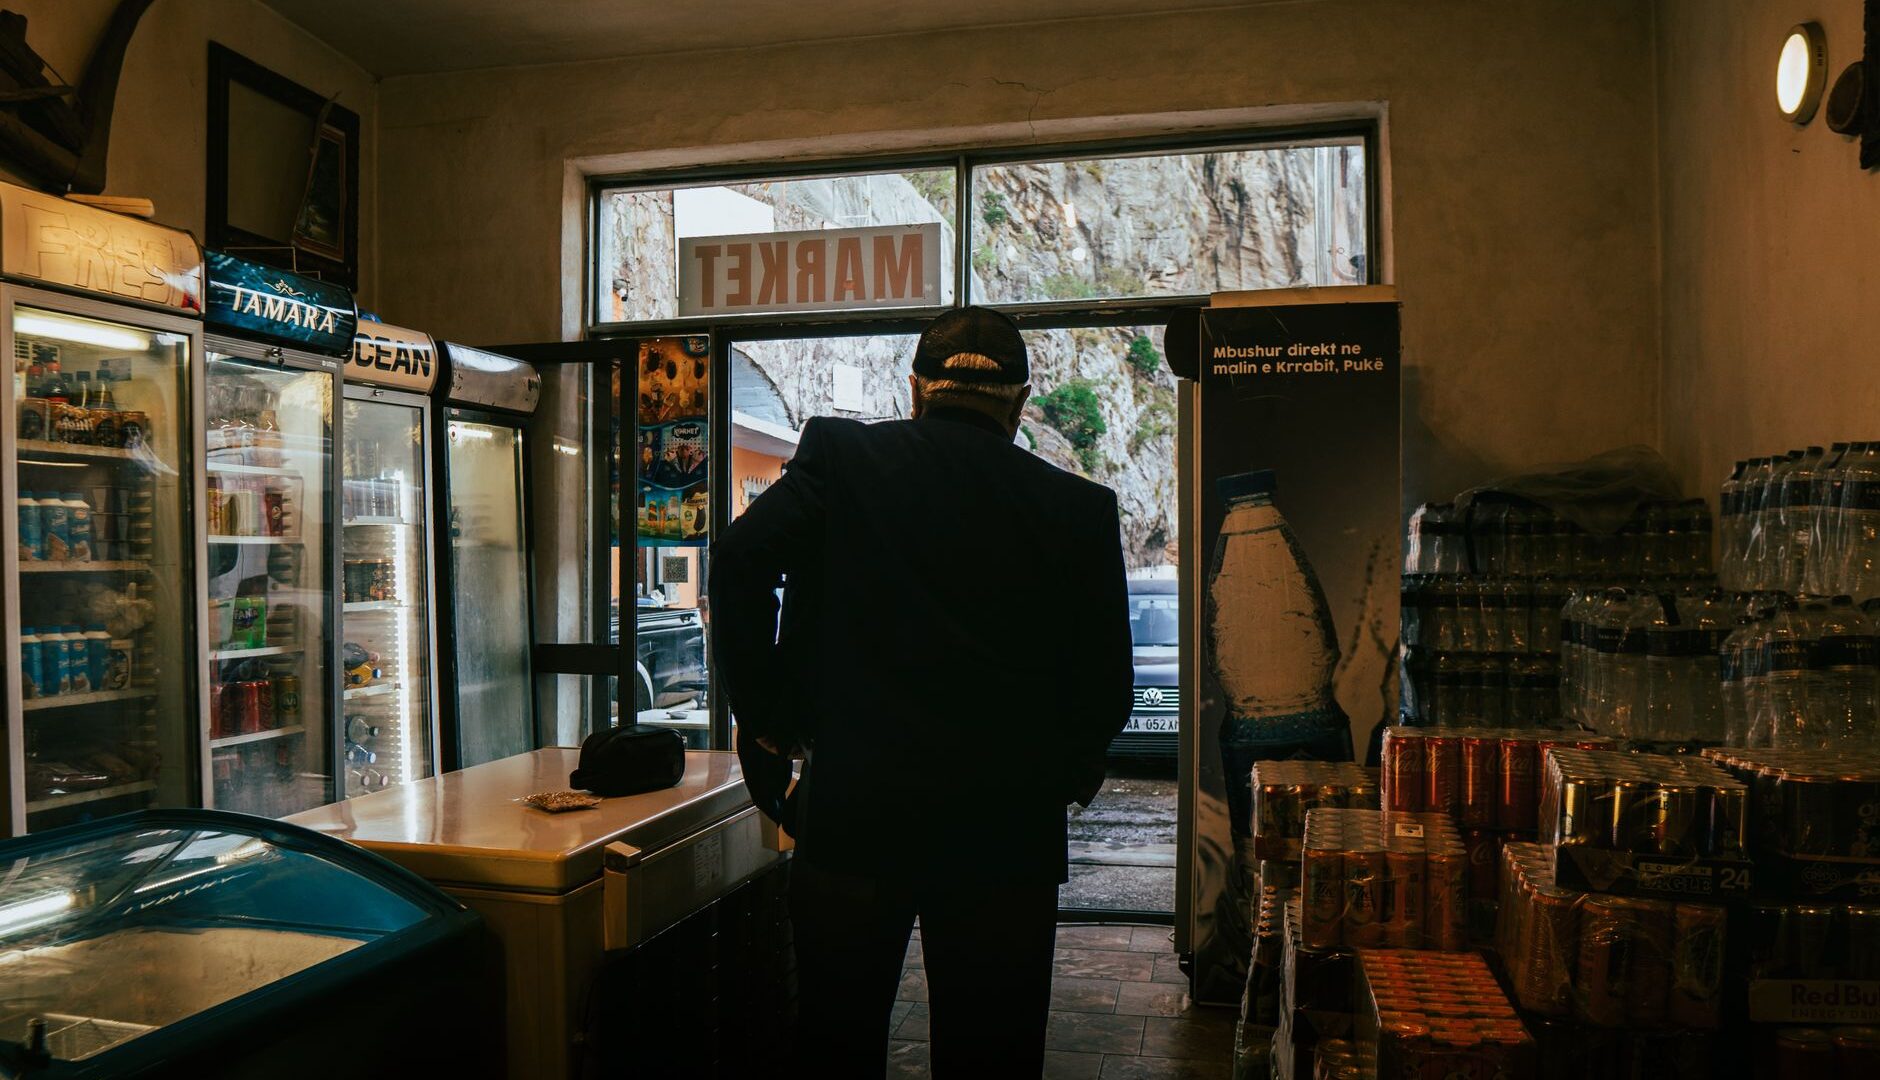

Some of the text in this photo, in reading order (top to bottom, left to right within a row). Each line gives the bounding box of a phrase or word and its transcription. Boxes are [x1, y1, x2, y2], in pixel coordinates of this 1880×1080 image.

[231, 284, 336, 334] TAMARA
[1213, 343, 1361, 359] Mbushur direkt ne
[1213, 358, 1384, 375] malin e Krrabit, Pukë
[1127, 718, 1139, 730] AA
[1146, 718, 1166, 730] 052
[1719, 867, 1752, 890] 24
[1791, 983, 1839, 1006] Red
